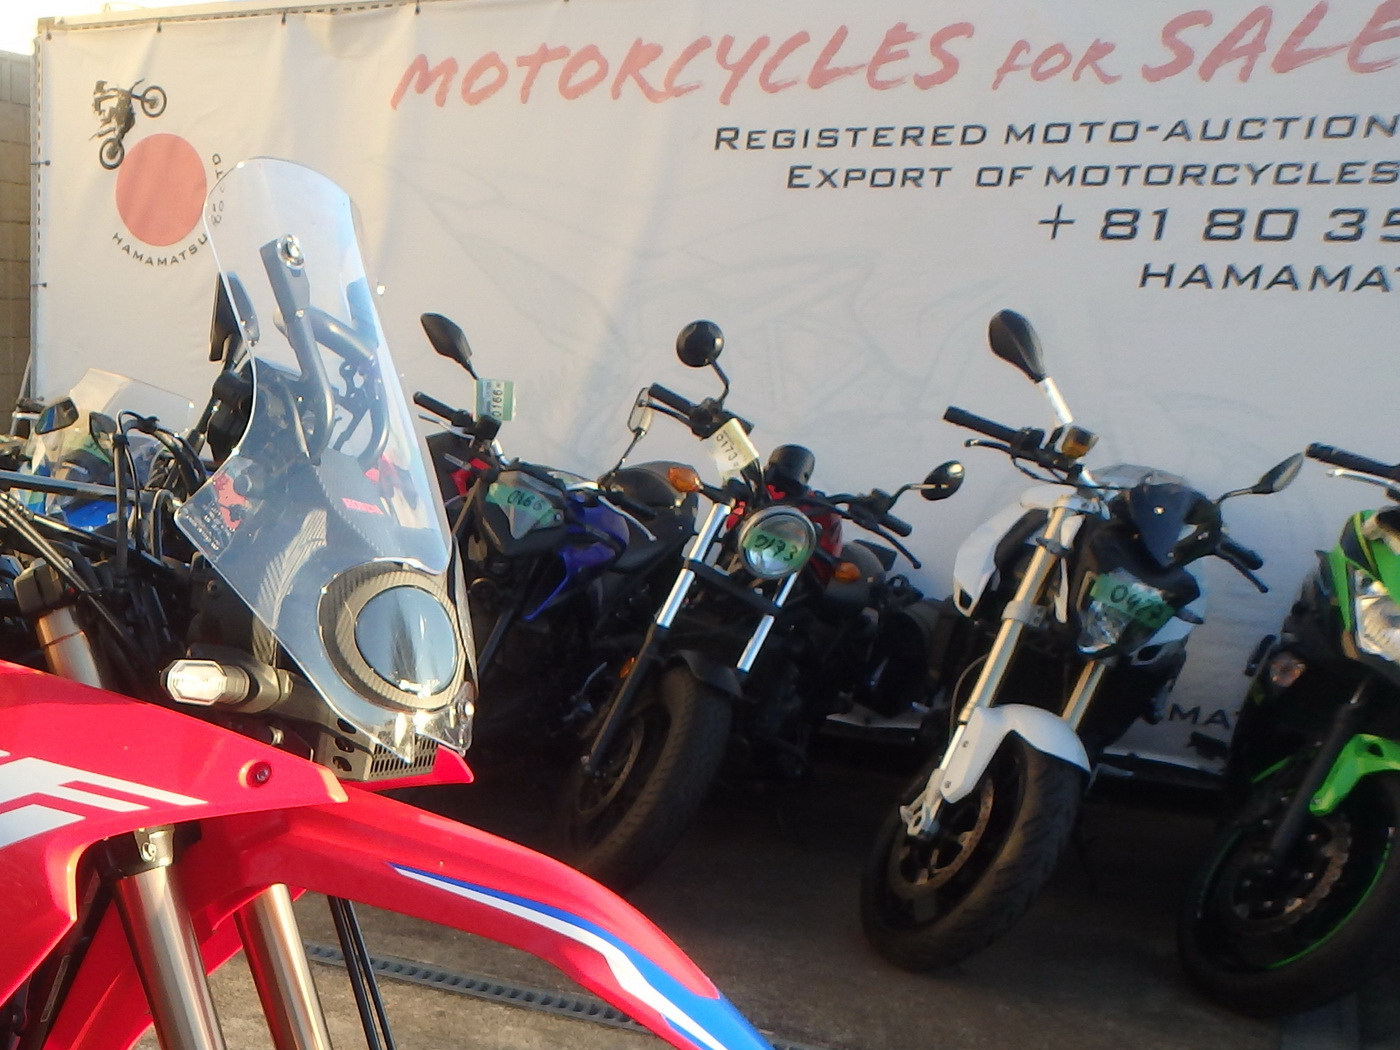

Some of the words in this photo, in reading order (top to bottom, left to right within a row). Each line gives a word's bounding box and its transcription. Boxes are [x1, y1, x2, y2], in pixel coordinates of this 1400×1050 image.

[390, 22, 975, 110] MOTORCYCLES
[1141, 0, 1400, 83] SALE
[975, 165, 1034, 188] OF
[1201, 206, 1300, 243] 80
[111, 231, 209, 267] HAMAMATSU
[1138, 262, 1400, 293] HAMAMA
